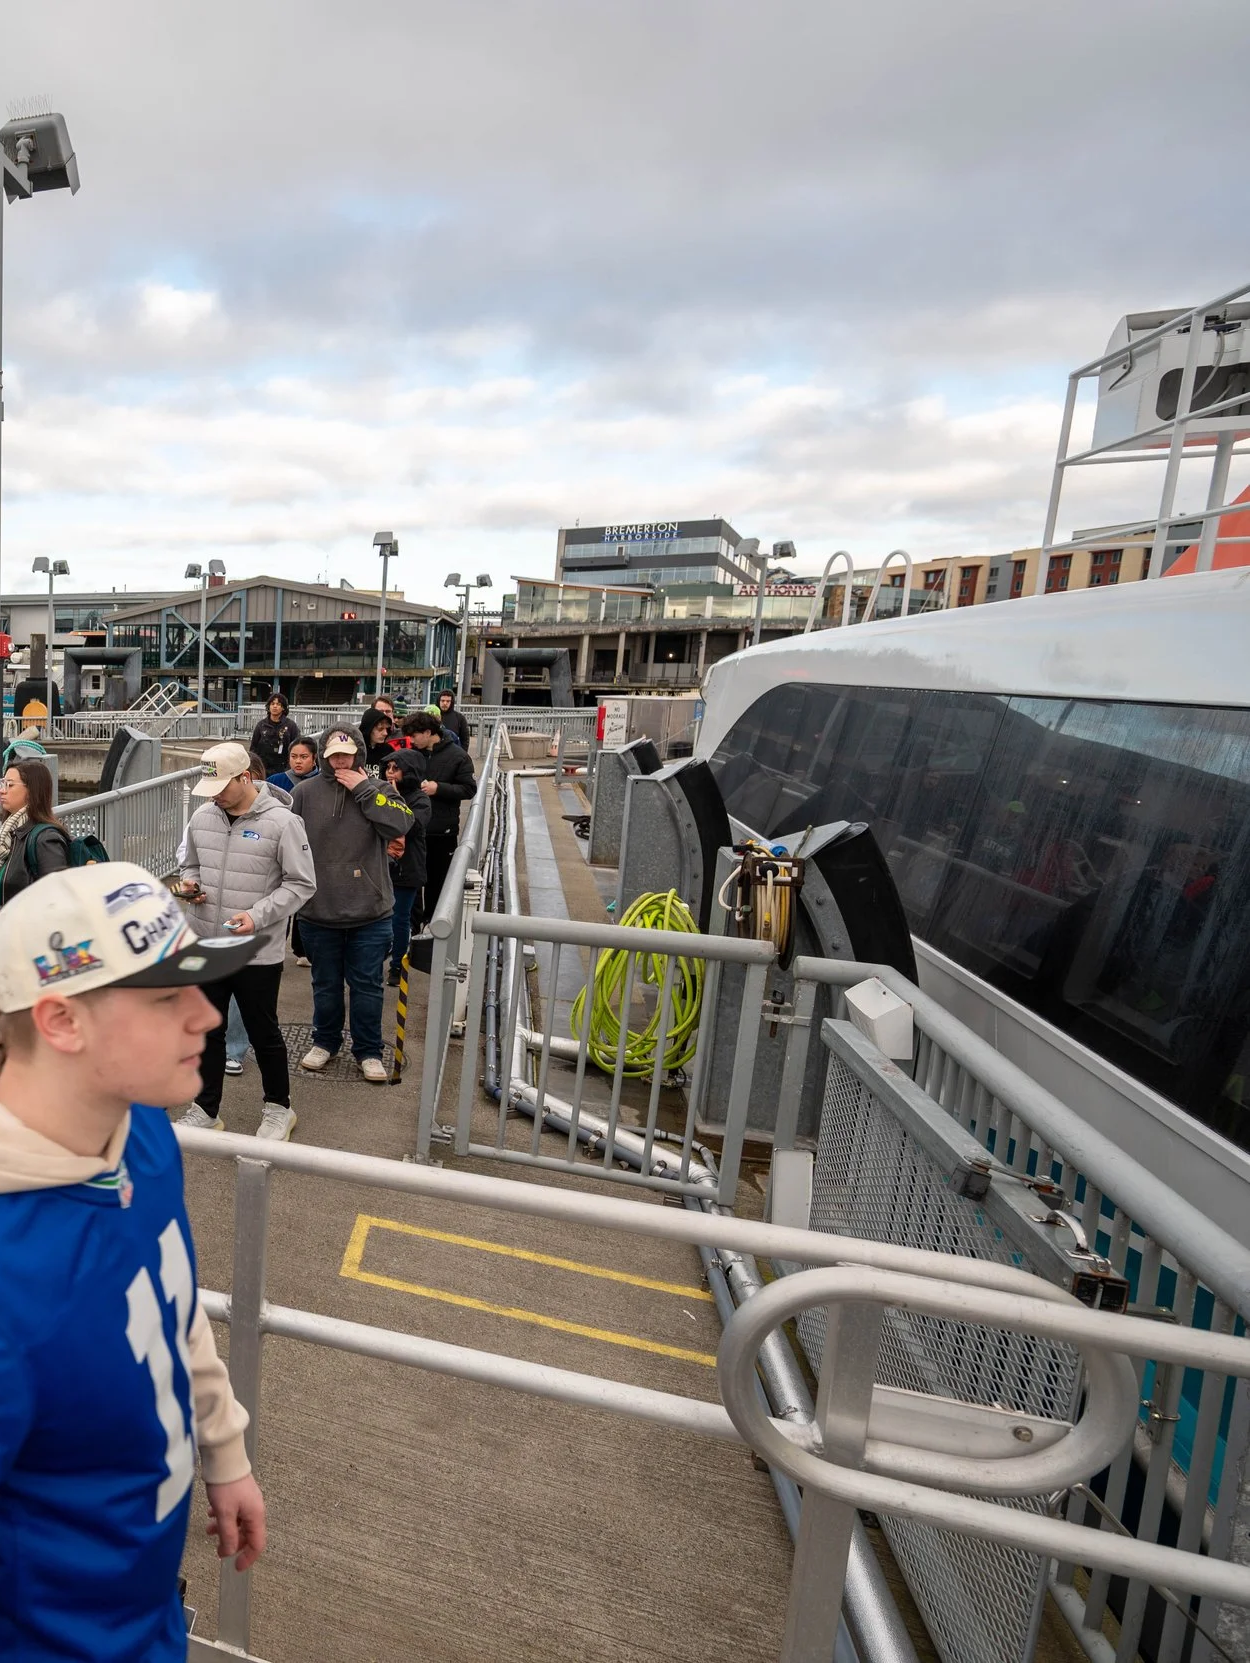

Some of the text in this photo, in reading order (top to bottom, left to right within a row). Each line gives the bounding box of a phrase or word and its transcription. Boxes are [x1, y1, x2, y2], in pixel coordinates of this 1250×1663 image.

[605, 522, 679, 535] BREMERTON
[604, 532, 678, 542] HARBORSIDE
[339, 734, 349, 743] W
[125, 1217, 198, 1523] 11
